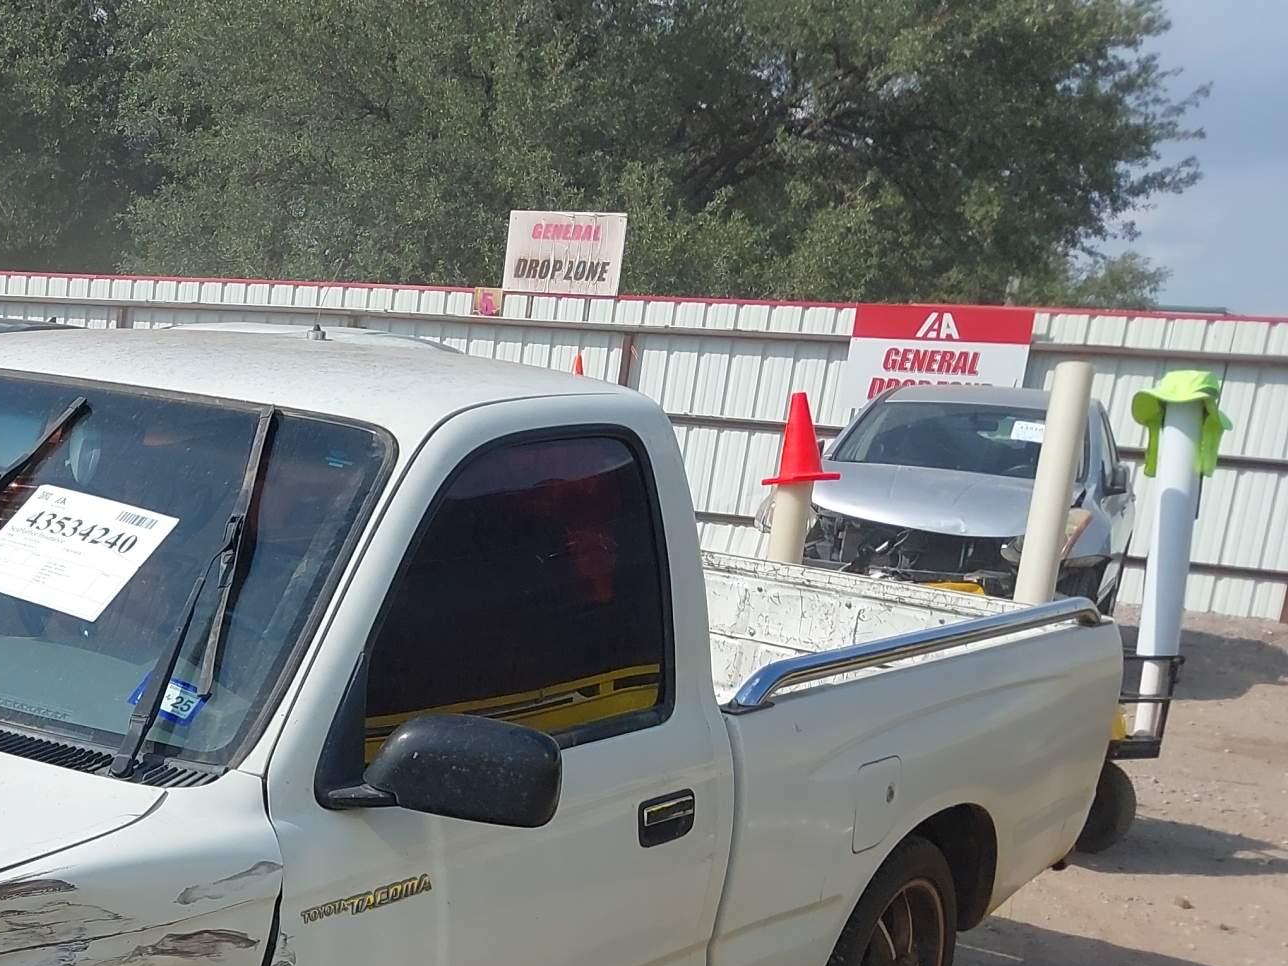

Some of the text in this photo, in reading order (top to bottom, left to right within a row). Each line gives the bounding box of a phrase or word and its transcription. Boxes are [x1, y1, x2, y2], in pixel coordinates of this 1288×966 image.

[531, 223, 601, 241] GENERAL
[513, 258, 563, 280] DROP
[882, 347, 981, 376] GENERAL
[26, 510, 139, 554] 43534240
[170, 695, 195, 713] 25
[300, 873, 433, 924] TOYOTA TACOMA
